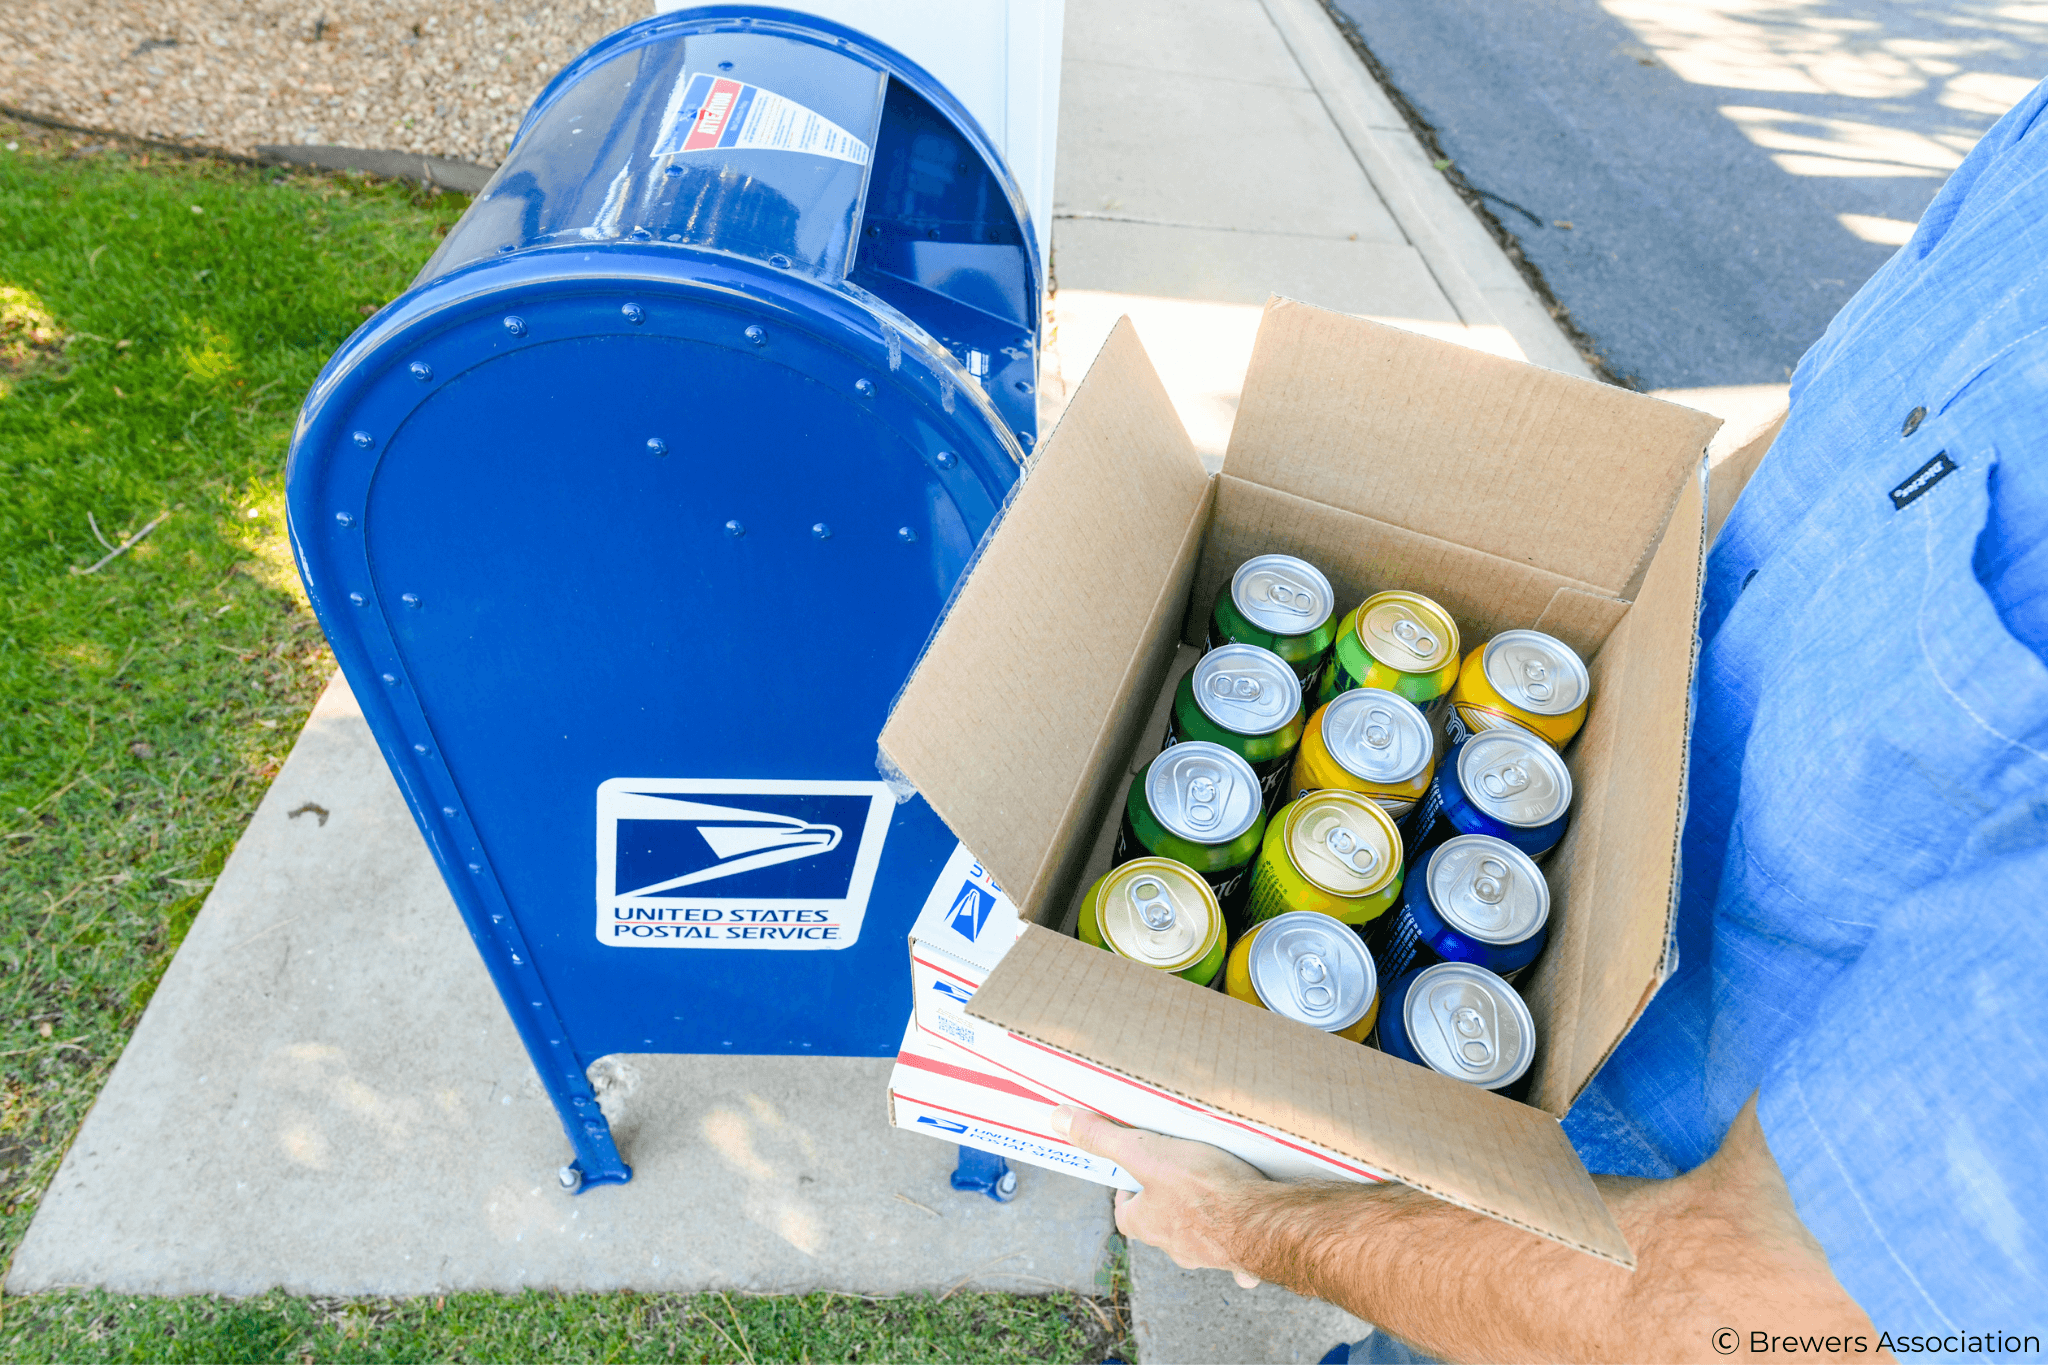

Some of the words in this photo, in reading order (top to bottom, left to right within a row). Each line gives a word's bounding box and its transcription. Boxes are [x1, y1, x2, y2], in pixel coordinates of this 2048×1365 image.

[697, 92, 733, 135] ATTENTION
[614, 907, 724, 922] UNITED
[729, 909, 829, 923] STATES
[614, 925, 719, 938] POSTAL
[726, 926, 839, 939] SERVICE
[969, 1133, 1027, 1151] POSTAL
[1031, 1149, 1097, 1172] SERVICE
[974, 1128, 1034, 1148] UNITED
[1037, 1144, 1093, 1164] STATES
